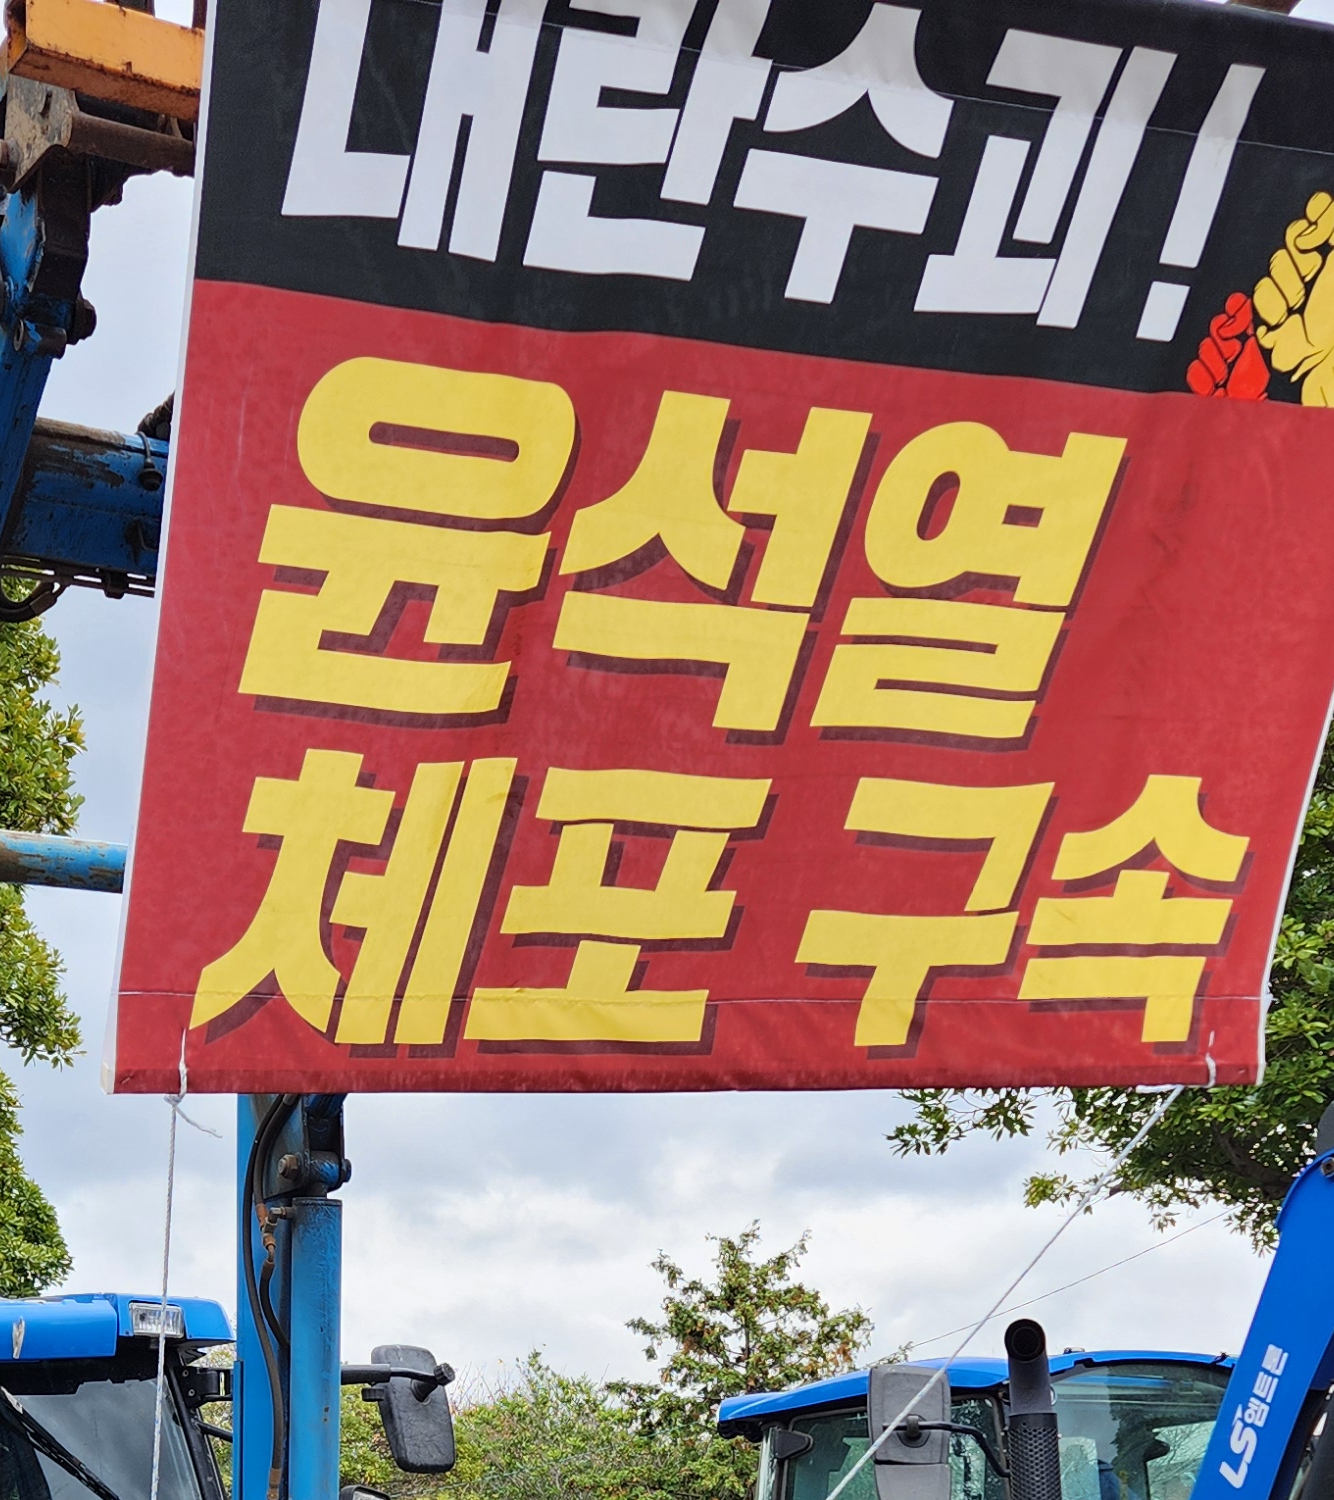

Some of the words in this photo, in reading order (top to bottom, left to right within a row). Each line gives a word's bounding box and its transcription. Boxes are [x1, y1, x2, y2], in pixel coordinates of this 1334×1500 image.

[281, 0, 1266, 342] 내란수괴!
[238, 356, 1135, 742] 윤석열
[189, 749, 775, 1046] 체포
[794, 774, 1251, 1048] 구속
